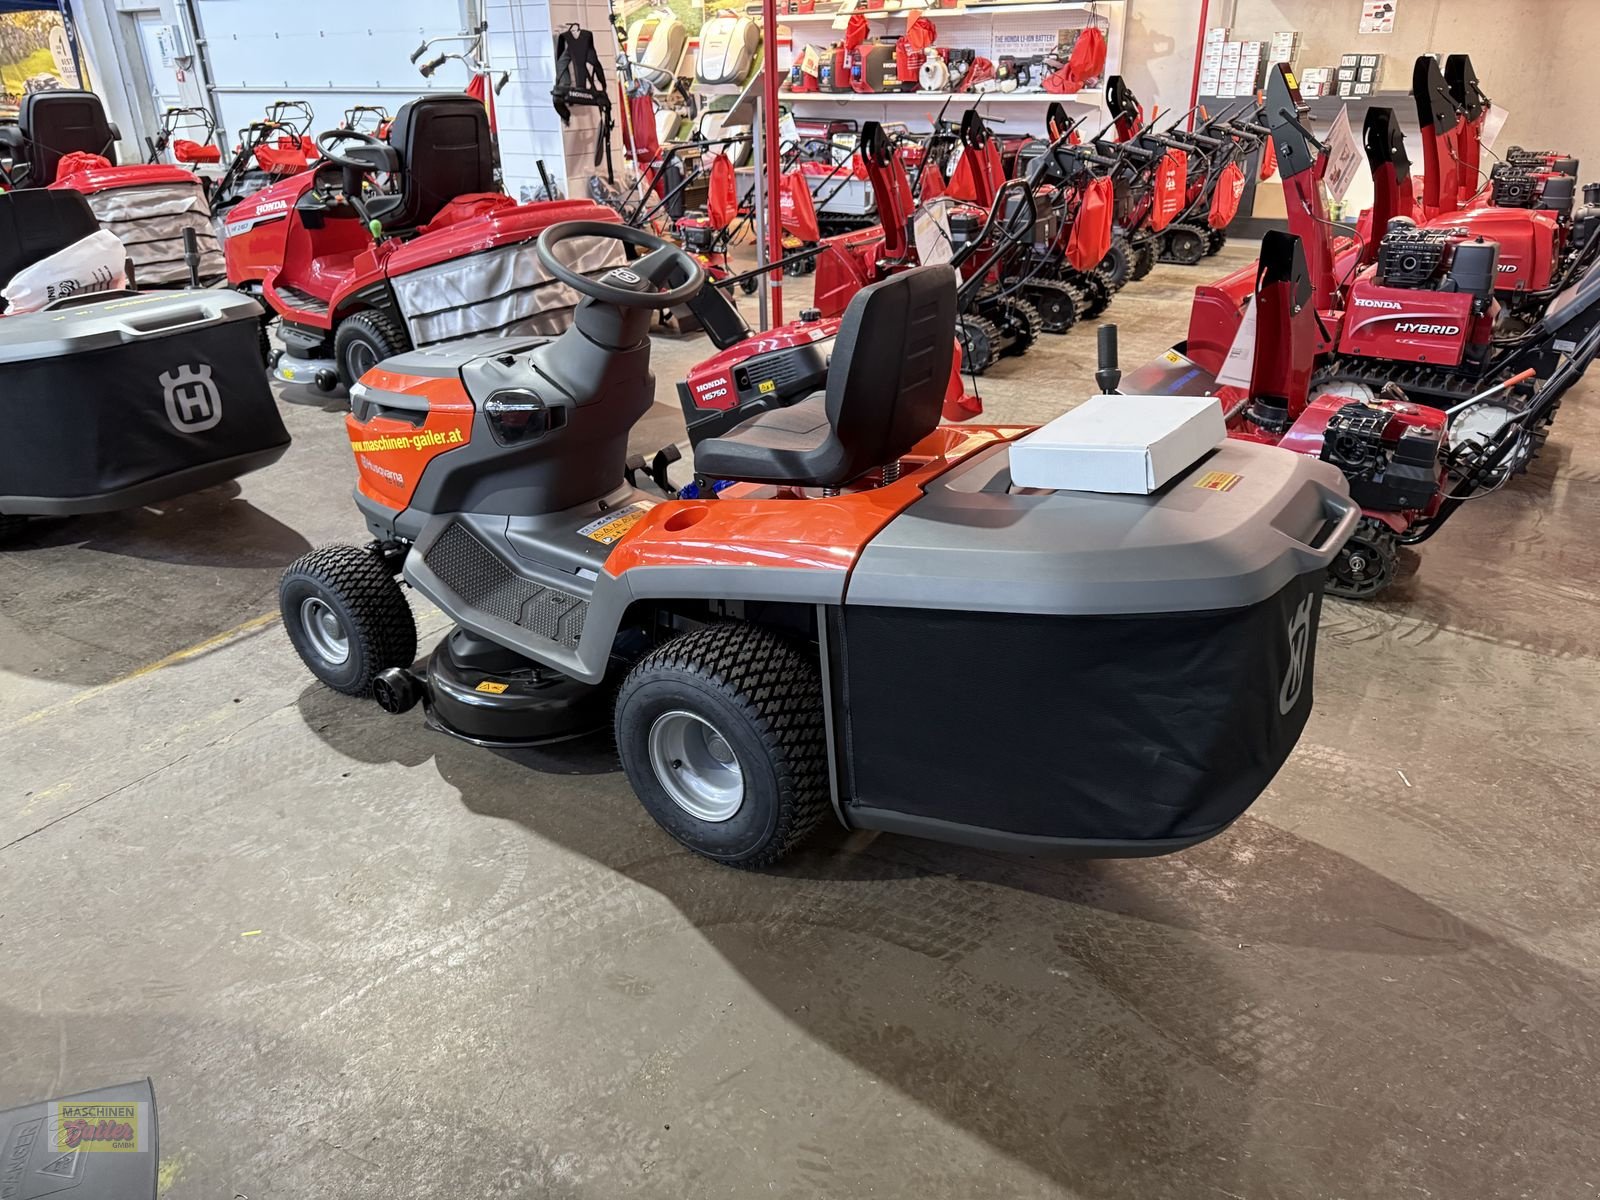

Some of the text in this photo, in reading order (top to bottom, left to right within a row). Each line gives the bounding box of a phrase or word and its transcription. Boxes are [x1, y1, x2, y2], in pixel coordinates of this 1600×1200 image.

[1035, 34, 1056, 42] BATTERY
[569, 91, 593, 100] HONDA
[256, 200, 288, 216] HONDA
[1496, 264, 1518, 273] RID
[1354, 298, 1402, 310] HONDA
[1394, 322, 1460, 336] HYBRID
[696, 377, 728, 393] HONDA
[702, 388, 728, 402] HS750
[366, 460, 404, 483] Husqvarna
